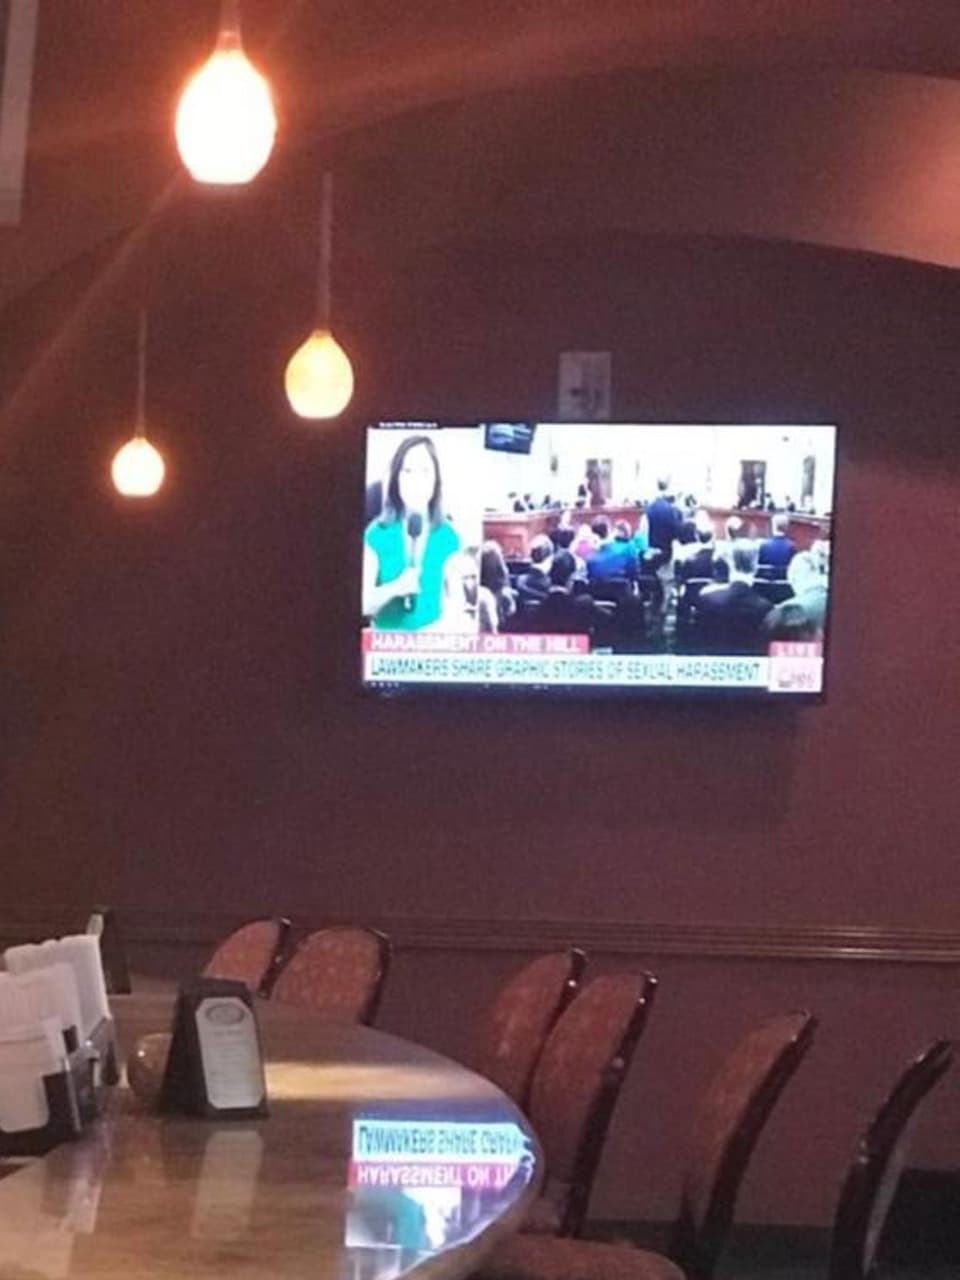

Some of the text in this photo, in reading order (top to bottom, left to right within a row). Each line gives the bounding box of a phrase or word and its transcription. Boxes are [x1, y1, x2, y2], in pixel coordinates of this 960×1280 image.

[371, 634, 582, 654] HARASSMENT ON THE HILL
[370, 656, 449, 676] LAWMAKERS
[452, 657, 492, 677] SHARE
[497, 658, 549, 678] GRAPHIC
[553, 660, 604, 679] STORIES
[607, 661, 623, 679] OF
[626, 660, 673, 681] SEXUAL
[677, 662, 759, 681] HARASSMENT
